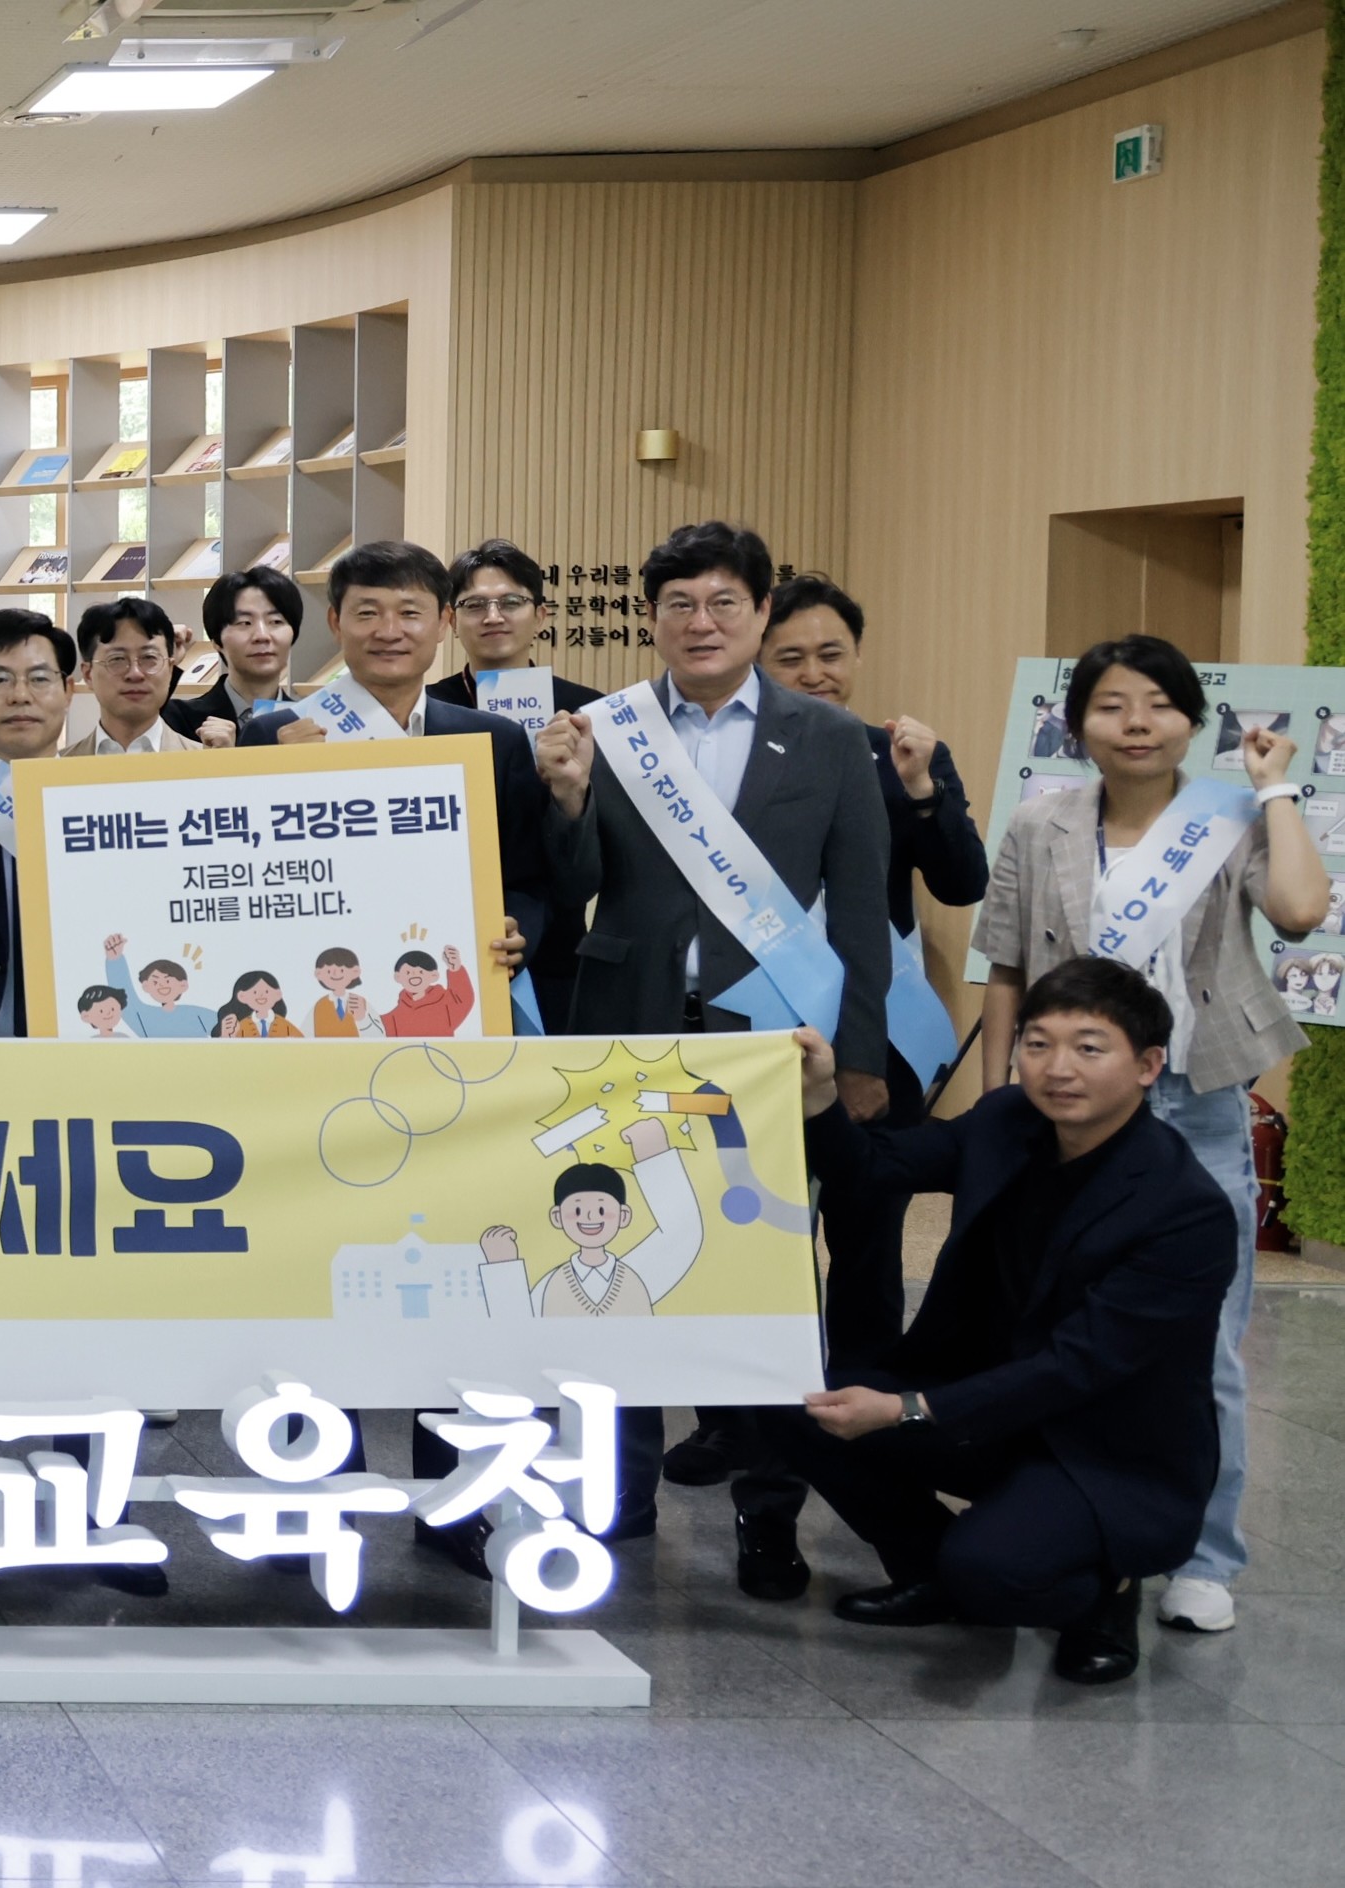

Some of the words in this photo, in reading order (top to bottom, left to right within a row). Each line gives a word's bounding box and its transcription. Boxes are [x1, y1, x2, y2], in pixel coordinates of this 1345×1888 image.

[566, 564, 632, 586] 우리를
[565, 595, 649, 617] 문학에는
[565, 626, 630, 648] 깃들어
[320, 692, 366, 734] 담배
[487, 698, 513, 712] 담배
[518, 697, 542, 710] NO,
[520, 717, 545, 729] YES
[605, 692, 638, 727] 담배
[689, 826, 748, 896] YES
[62, 810, 169, 853] 담배는
[178, 806, 261, 849] 선택,
[270, 799, 379, 843] 건강은
[388, 794, 461, 835] 결과
[1162, 821, 1210, 874] 담배
[182, 861, 254, 891] 지금의
[261, 858, 334, 886] 선택이
[169, 896, 240, 924] 미래를
[249, 890, 352, 921] 바꿉니다.
